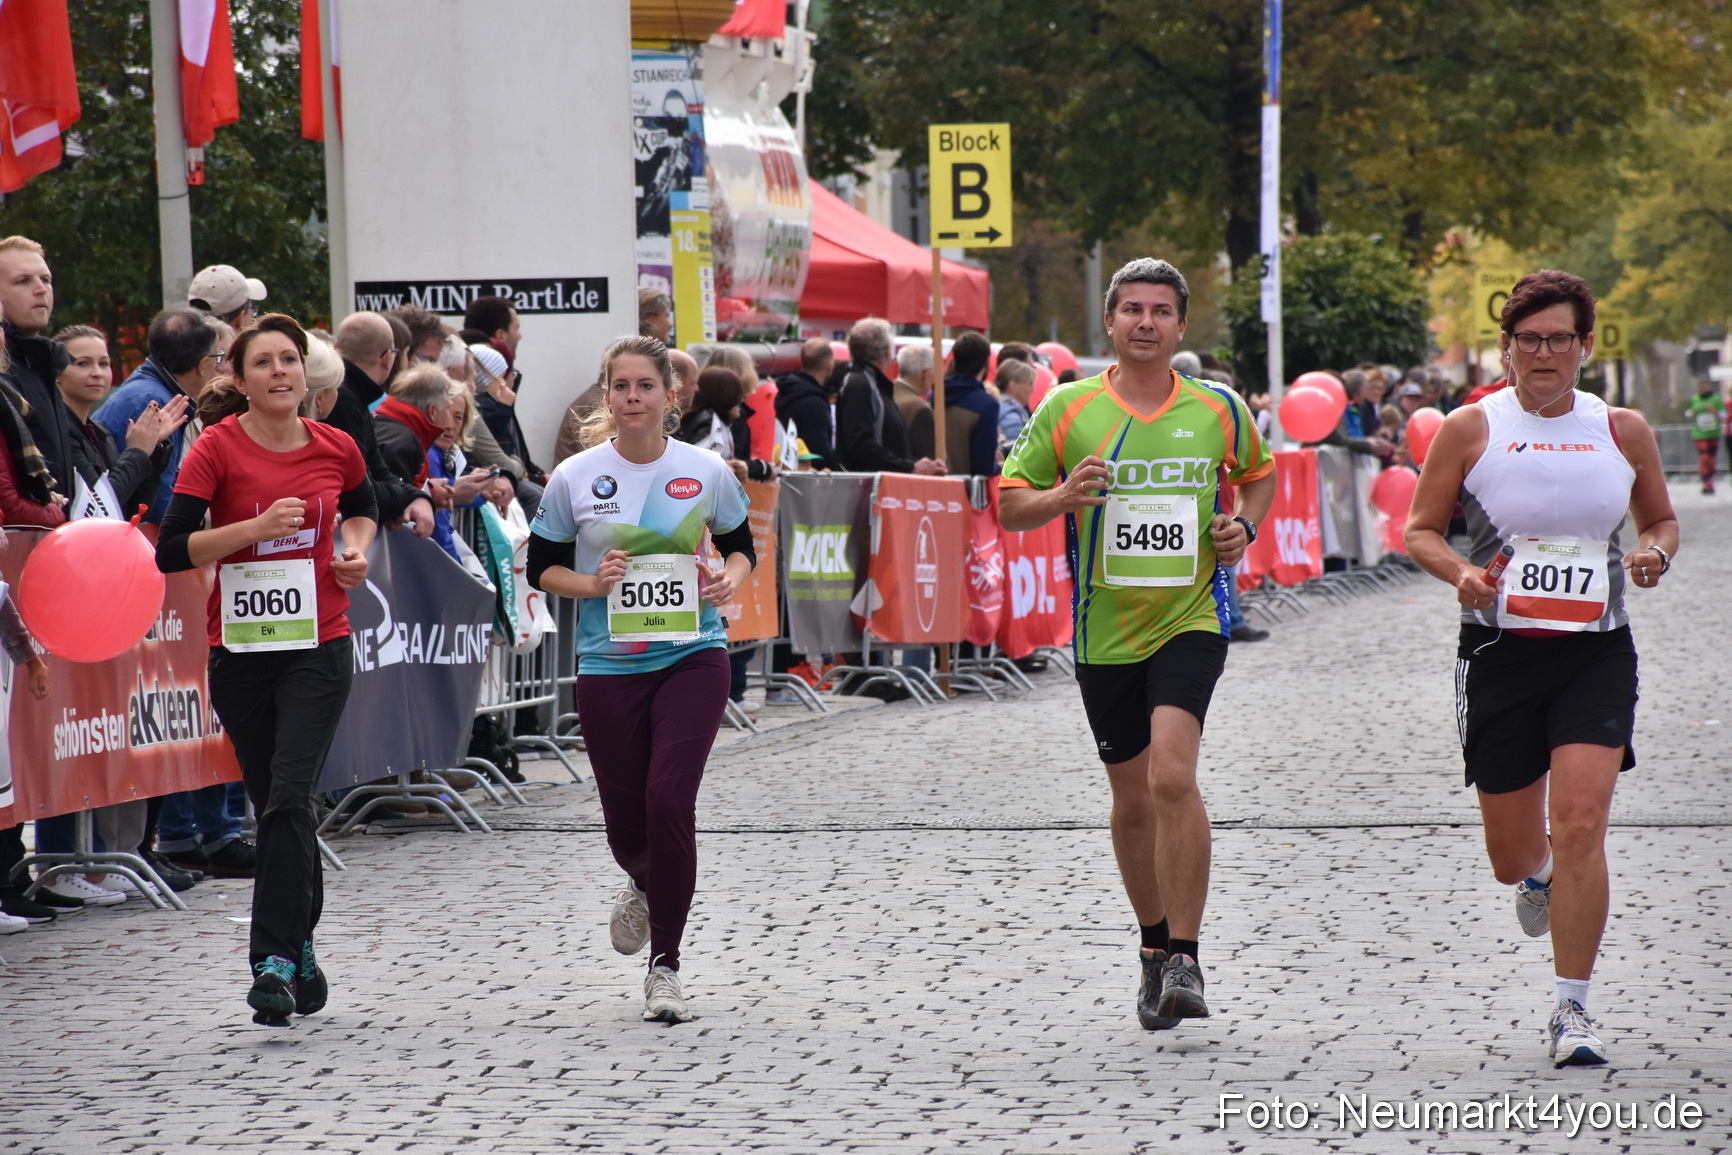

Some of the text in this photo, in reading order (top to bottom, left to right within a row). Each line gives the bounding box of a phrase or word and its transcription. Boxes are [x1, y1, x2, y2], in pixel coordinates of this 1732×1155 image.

[939, 130, 1001, 152] Block
[951, 162, 991, 220] B
[675, 229, 699, 252] 18.
[1481, 274, 1517, 287] Block
[1487, 290, 1509, 324] C
[1602, 324, 1621, 348] D
[1533, 443, 1600, 452] KLEBL
[670, 482, 699, 495] Hervis
[593, 502, 620, 511] PARTL
[1138, 503, 1171, 512] BOCK
[273, 536, 300, 548] DEHN
[1116, 523, 1184, 551] 5498
[789, 528, 852, 575] BOCK
[1548, 544, 1581, 554] BOCK
[252, 568, 287, 579] BOCK
[641, 562, 674, 570] BOCK
[1489, 562, 1505, 578] 8017
[1521, 562, 1594, 595] 8017
[234, 588, 301, 618] 5060
[621, 581, 684, 608] 5035
[165, 609, 183, 641] die
[261, 625, 275, 636] Evi
[643, 616, 666, 627] Julia
[399, 622, 493, 665] RAIL.ONE
[54, 707, 125, 761] schönsten
